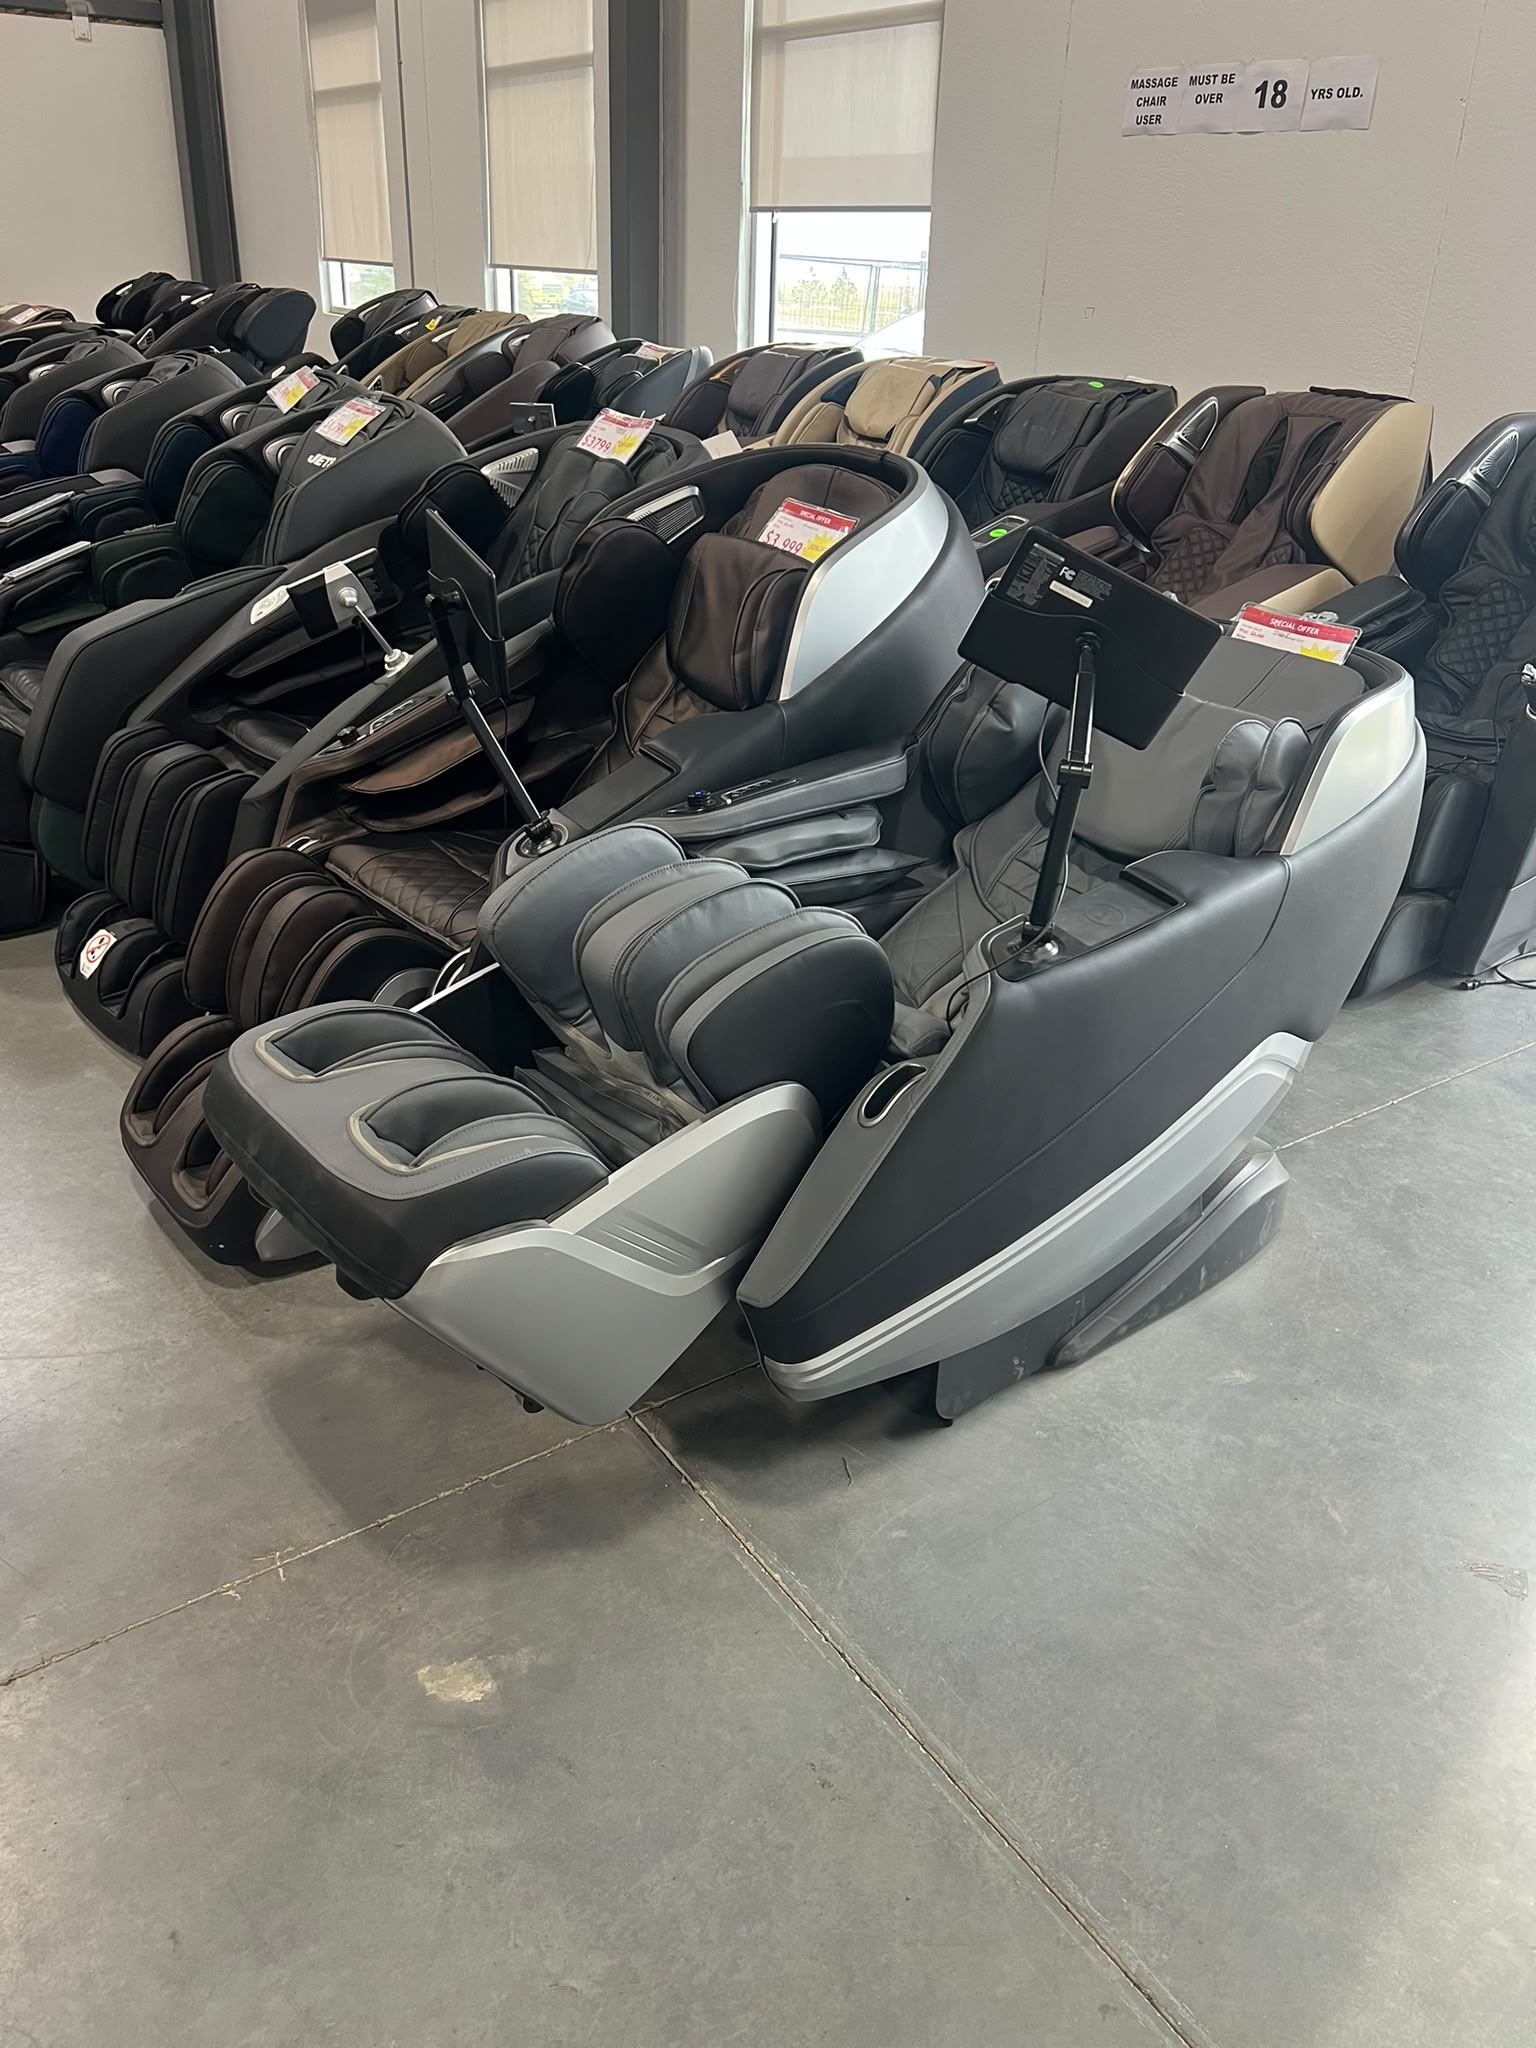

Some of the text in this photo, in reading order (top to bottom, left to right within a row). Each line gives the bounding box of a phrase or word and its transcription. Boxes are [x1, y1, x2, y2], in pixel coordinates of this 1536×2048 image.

[1130, 76, 1179, 90] MASSAGE
[1188, 73, 1236, 87] MUST BE
[1194, 93, 1224, 105] OVER
[1254, 79, 1288, 109] 18
[1310, 86, 1364, 100] YRS OLD.
[1136, 95, 1167, 108] CHAIR
[1135, 114, 1162, 126] USER
[582, 434, 612, 452] $3799
[800, 510, 816, 520] SPECIAL
[816, 515, 831, 525] OFFER
[765, 529, 803, 553] $3999
[1269, 617, 1296, 630] SPECIAL
[1297, 625, 1320, 636] OFFER
